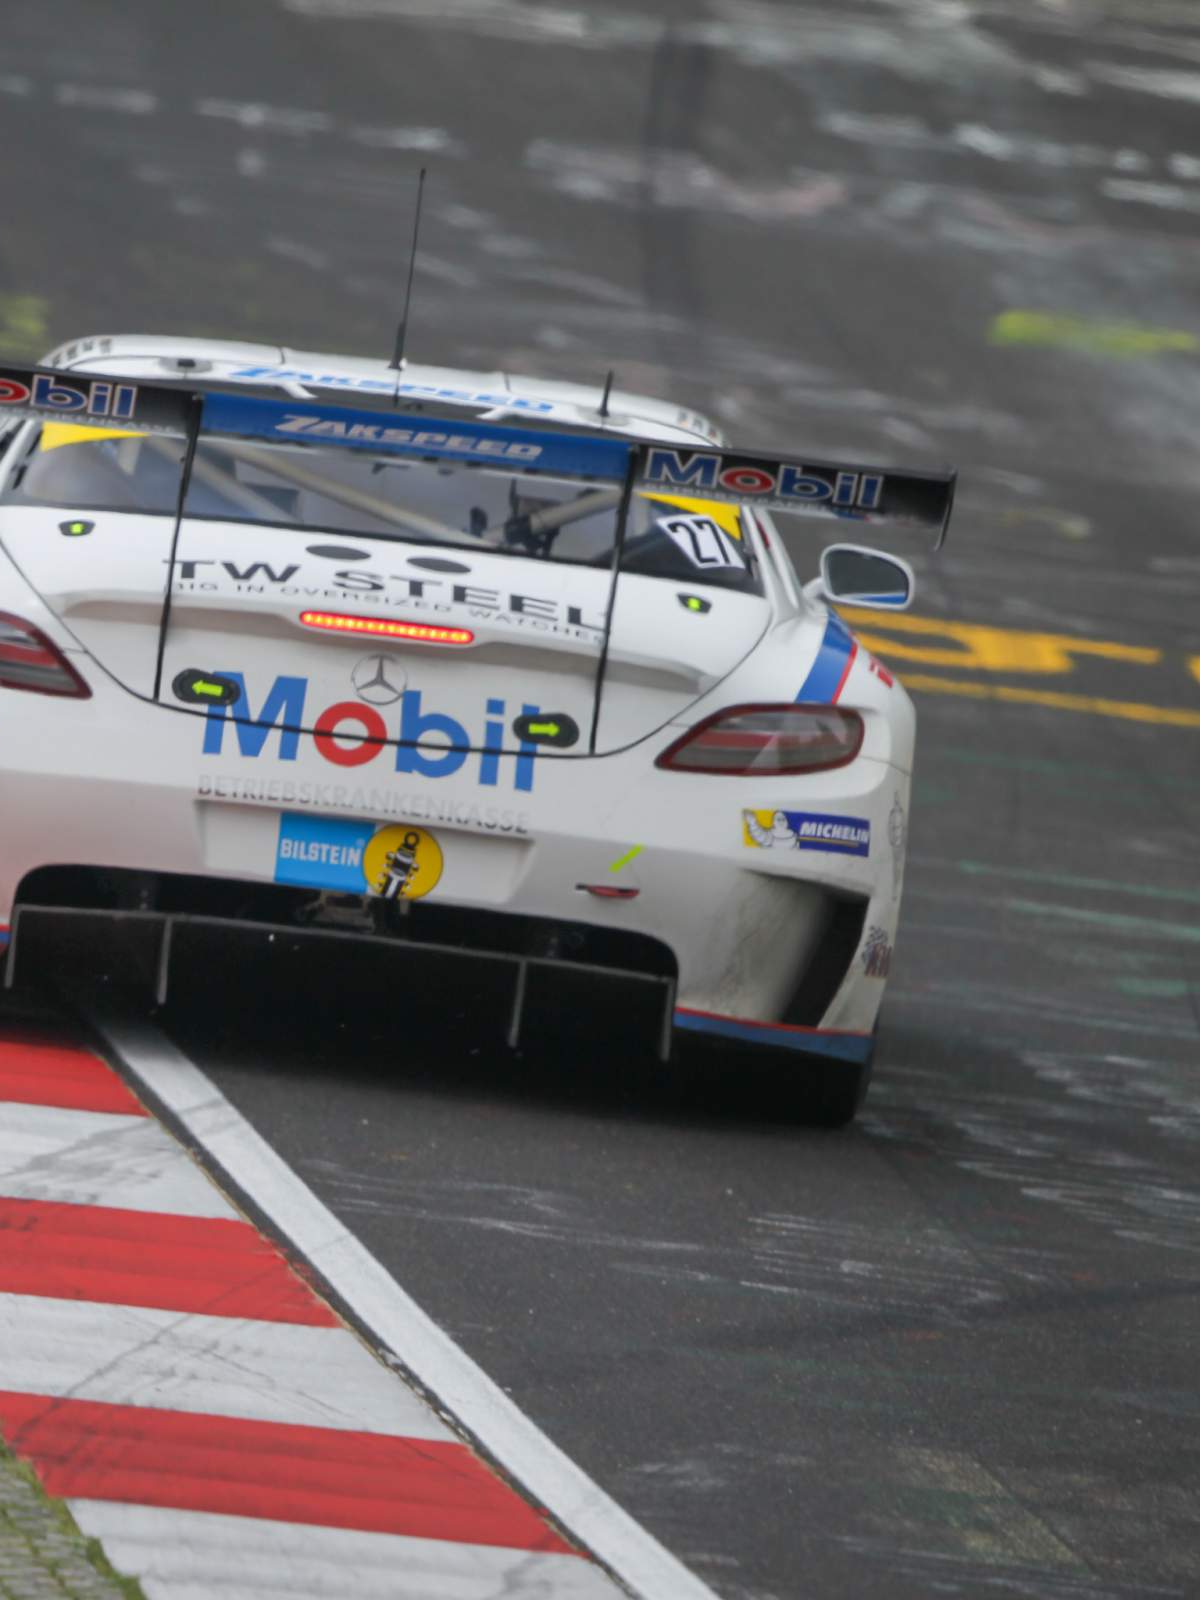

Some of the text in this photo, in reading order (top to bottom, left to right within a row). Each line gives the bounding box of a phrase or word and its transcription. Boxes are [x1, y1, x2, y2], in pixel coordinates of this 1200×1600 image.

[275, 415, 543, 462] ZAKSPEED
[644, 447, 884, 508] Mobil
[667, 518, 731, 566] 27
[163, 560, 606, 633] TW STEEL
[237, 584, 264, 594] IN
[281, 586, 452, 613] OVERSIZED
[202, 670, 541, 792] Mobil
[198, 774, 532, 834] BETRIEBSKRANKENKASSE
[279, 837, 363, 868] BILSTEIN
[800, 821, 869, 844] MICHELIN
